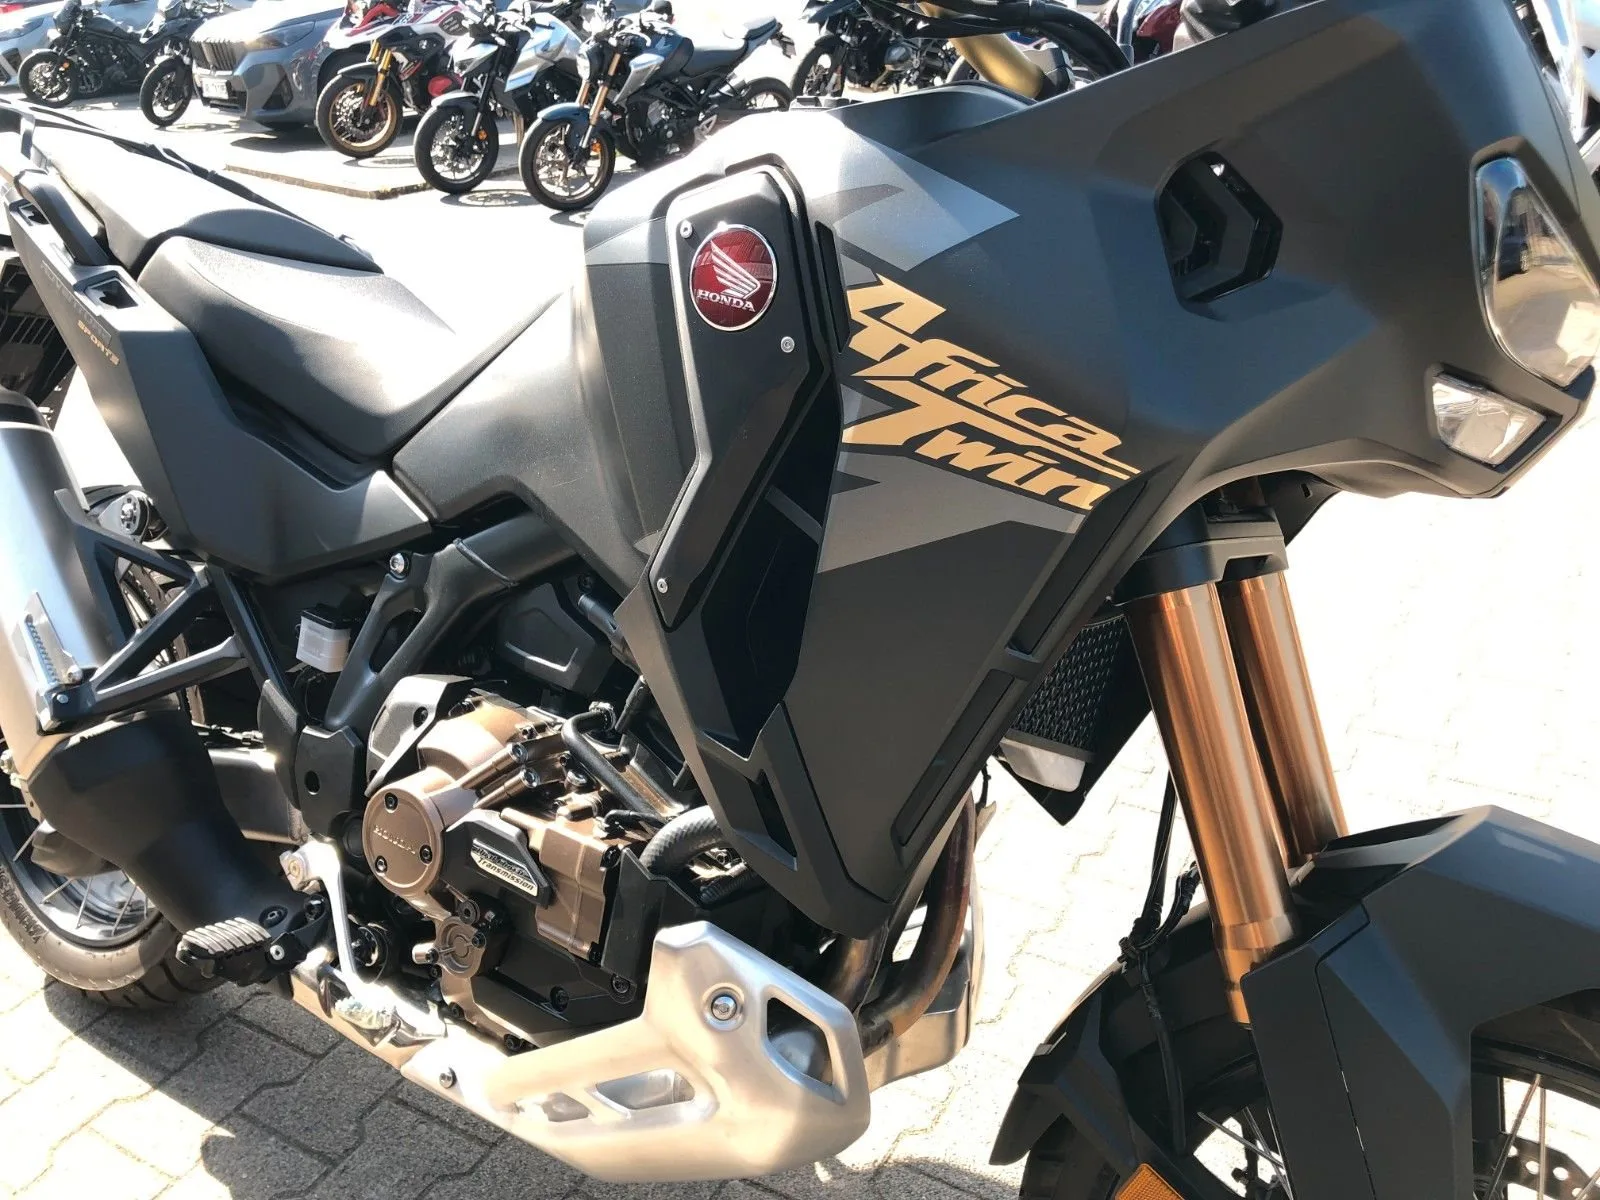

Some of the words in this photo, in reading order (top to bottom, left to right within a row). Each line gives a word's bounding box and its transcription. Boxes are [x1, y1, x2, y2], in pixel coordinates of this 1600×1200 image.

[696, 288, 756, 312] HONDA
[77, 319, 120, 366] SPORTS
[847, 273, 1141, 474] Africa
[842, 379, 1130, 511] Twin
[478, 857, 535, 891] Transmission
